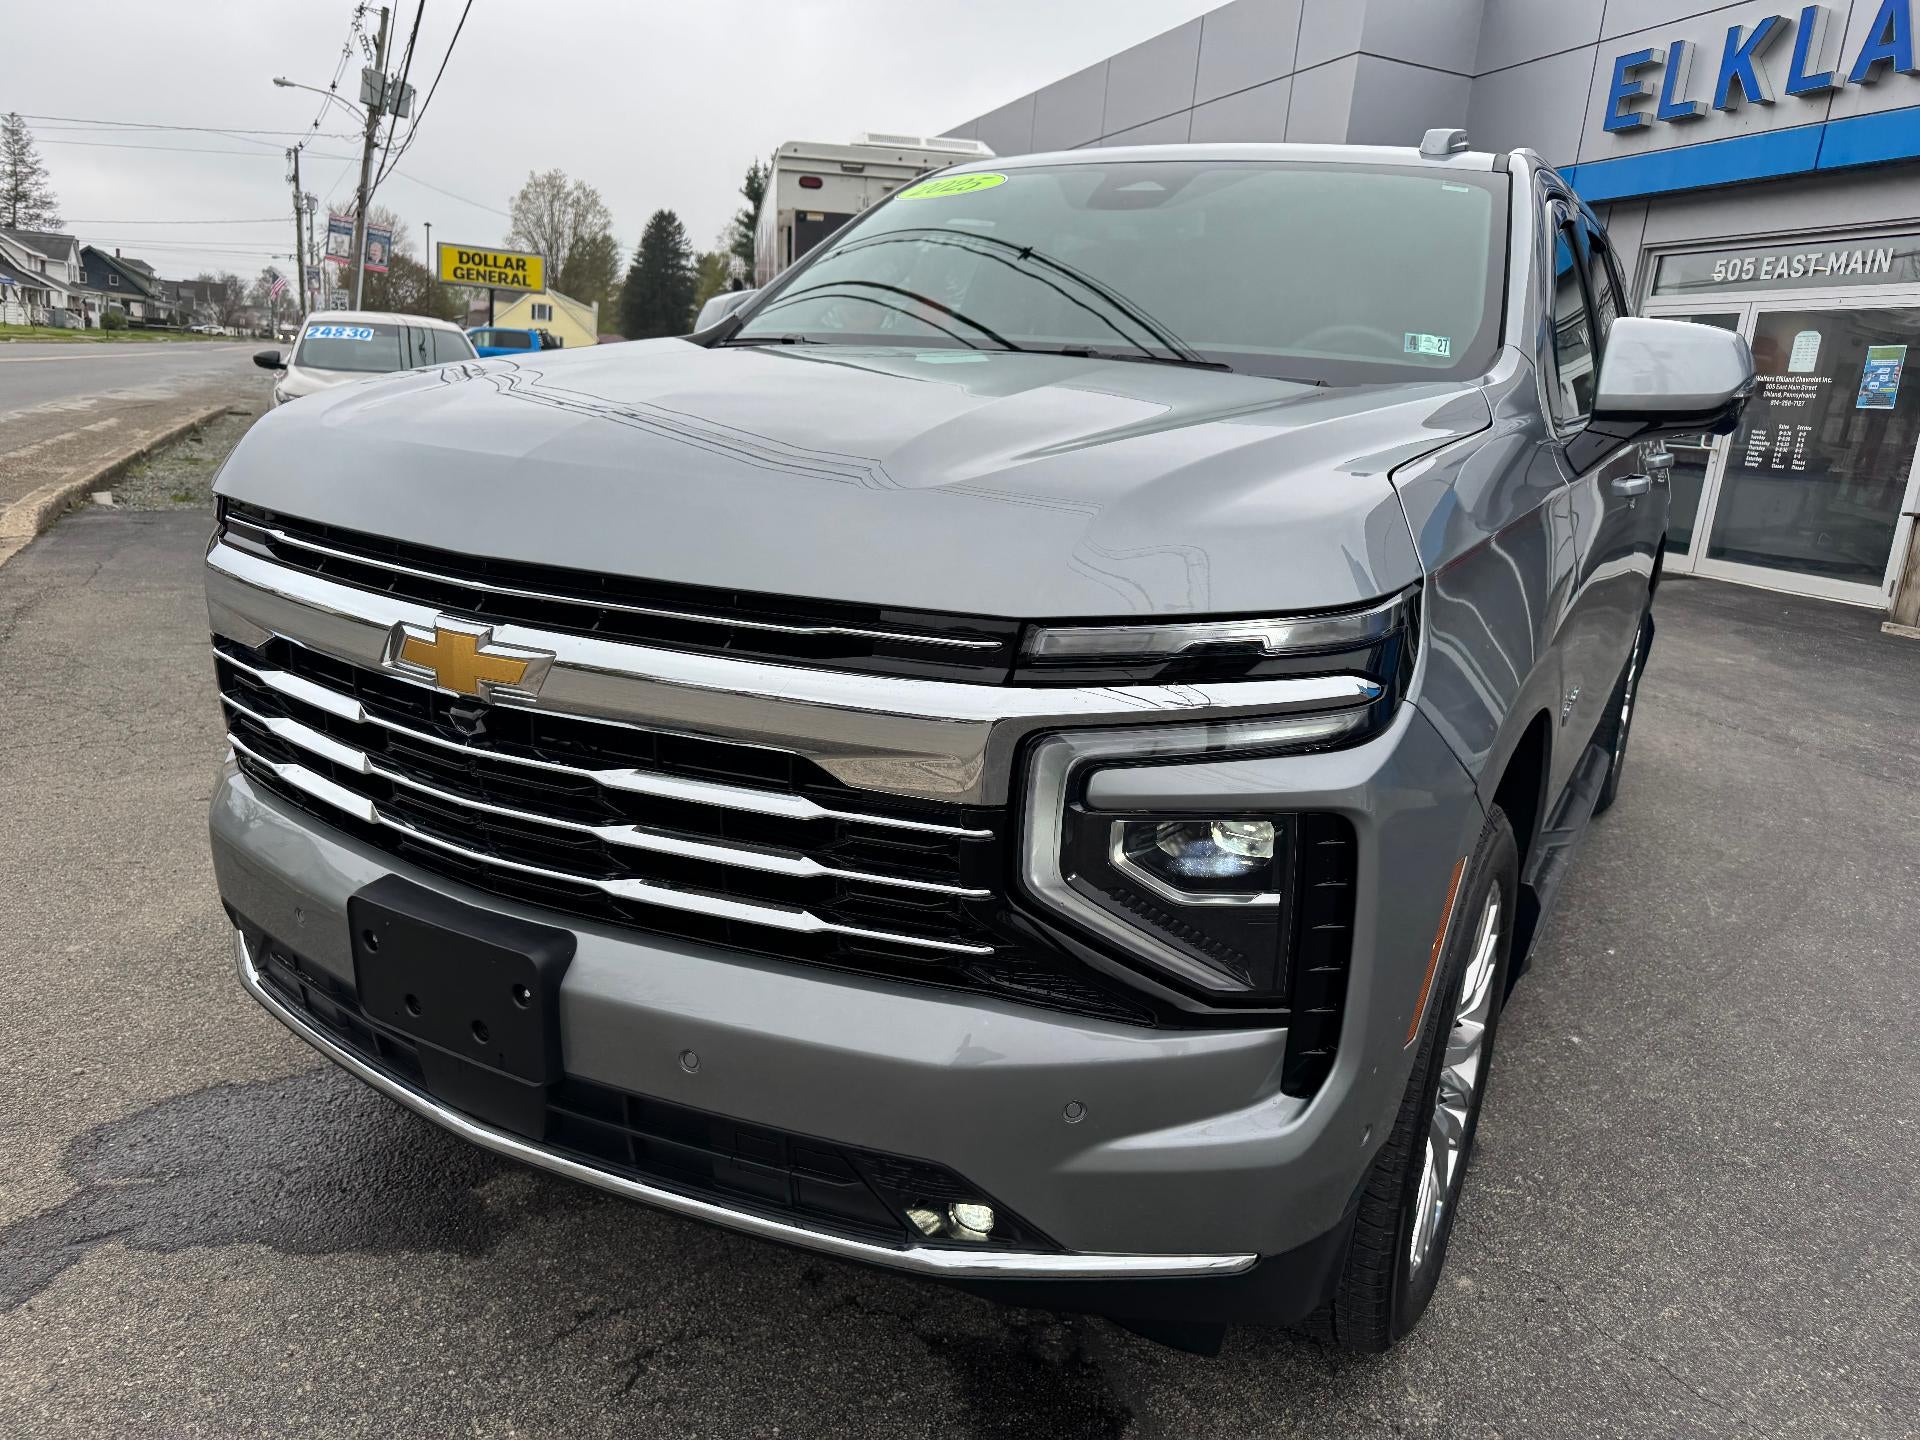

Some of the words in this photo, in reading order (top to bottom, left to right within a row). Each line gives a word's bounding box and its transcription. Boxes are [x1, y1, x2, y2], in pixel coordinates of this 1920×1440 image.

[1603, 0, 1919, 133] ELKLA
[907, 176, 995, 197] 2025
[457, 250, 527, 272] DOLLAR
[1713, 257, 1756, 281] 505
[1760, 252, 1823, 280] EAST
[1826, 247, 1894, 276] MAIN
[452, 266, 532, 287] GENERAL
[331, 301, 348, 311] 35
[1410, 335, 1418, 350] 4
[1437, 338, 1448, 354] 27
[1783, 391, 1817, 400] Pennsylvania
